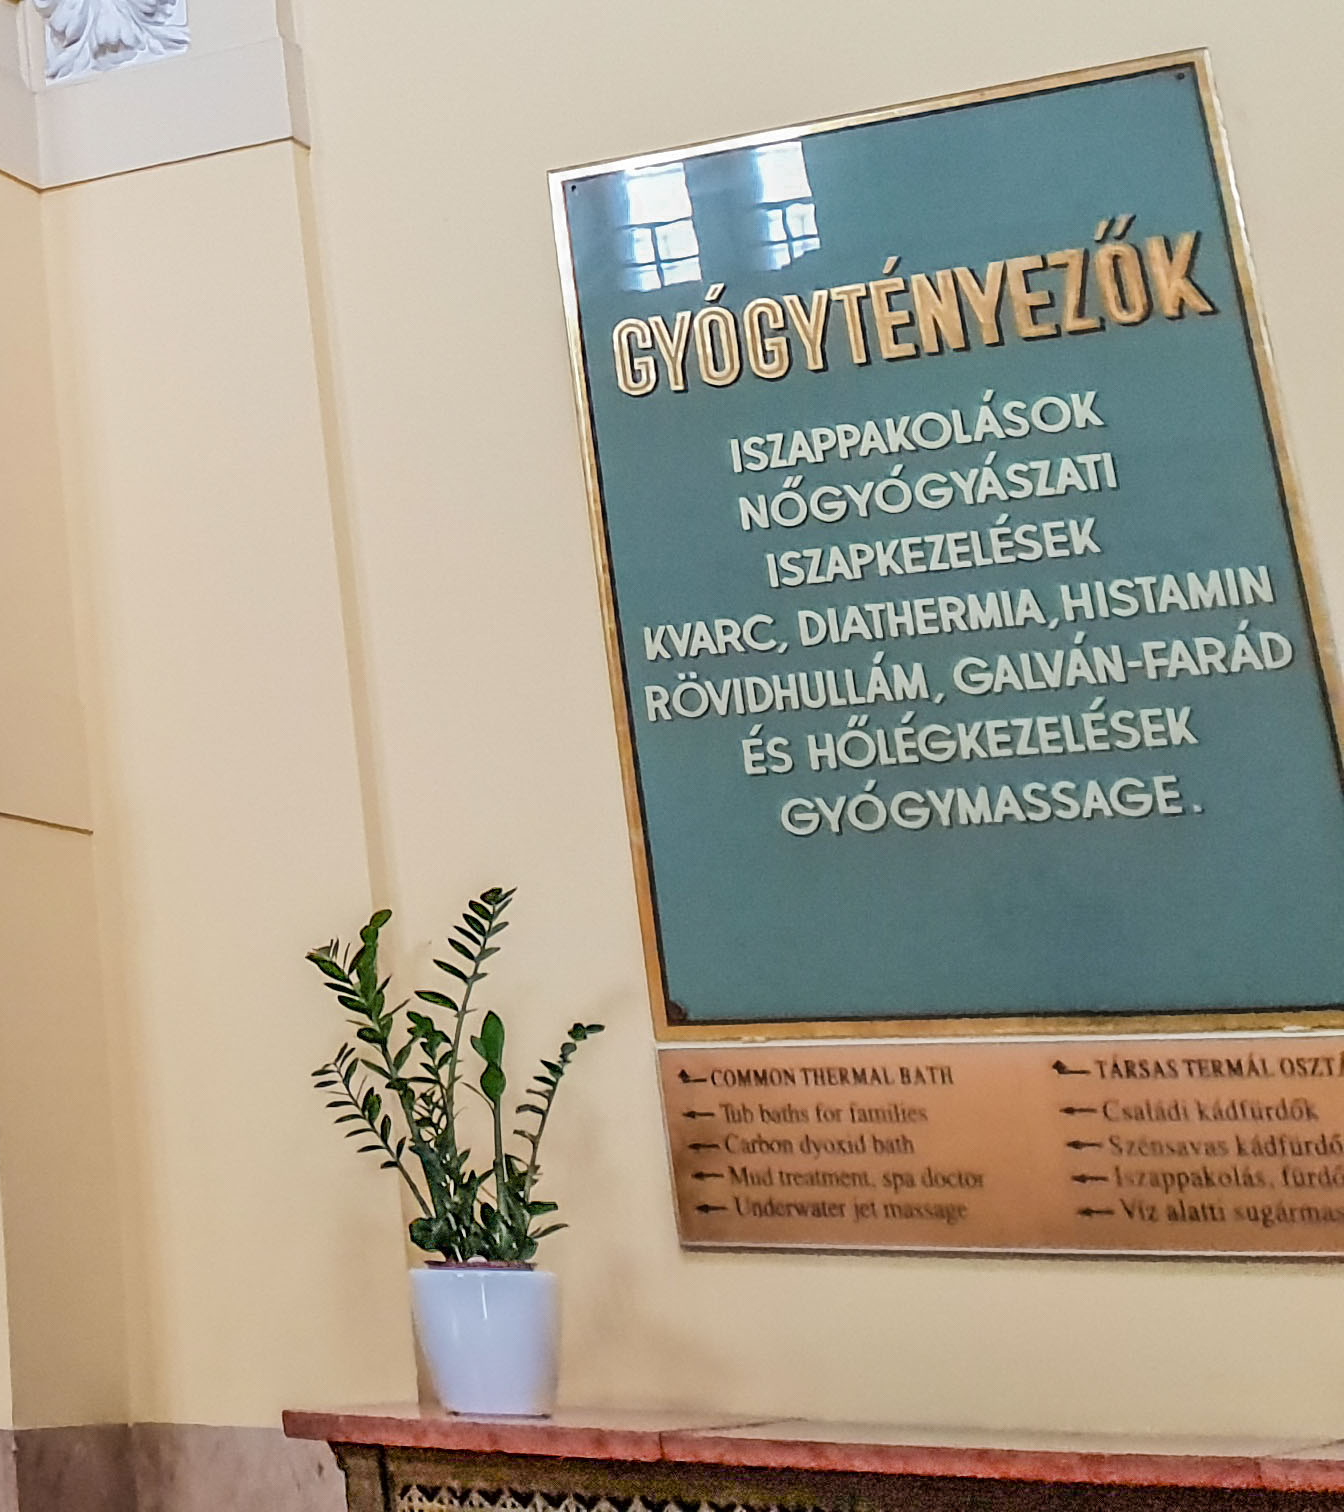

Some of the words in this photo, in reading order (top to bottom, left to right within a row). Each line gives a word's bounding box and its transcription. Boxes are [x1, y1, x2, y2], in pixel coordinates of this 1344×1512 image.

[612, 214, 1218, 396] GYÓGYTÉNYEZŐK
[730, 389, 1104, 473] ISZAPPAKOLÁSOK
[739, 451, 1118, 531] NŐGYÓGYÁSZATI
[766, 513, 1101, 588] ISZAPKEZELÉSEK
[643, 614, 788, 660] KVARC,
[798, 589, 1059, 646] DIATHERMIA,
[1060, 565, 1274, 621] HISTAMIN
[644, 651, 945, 721] RÖVIDHULLÁM,
[953, 619, 1293, 695] GALVÁN-FARÁD
[742, 724, 795, 775] ÉS
[807, 696, 1199, 770] HŐLÉGKEZELÉSEK
[711, 1067, 796, 1086] COMMON
[800, 1066, 896, 1086] THERMAL
[900, 1065, 954, 1085] BATH
[1095, 1055, 1178, 1079] TÁRSAS
[1182, 1052, 1275, 1078] TERMÁL
[719, 1102, 754, 1124] Tub
[760, 1102, 810, 1124] baths
[815, 1101, 844, 1123] for
[849, 1101, 928, 1124] families
[1102, 1098, 1188, 1122] Családi
[725, 1133, 793, 1155] Carbon
[799, 1134, 866, 1159] dyoxid
[873, 1134, 915, 1155] bath
[728, 1165, 772, 1188] Mud
[882, 1171, 917, 1194] spa
[921, 1166, 984, 1188] doctor
[733, 1195, 845, 1218] Underwater
[852, 1198, 877, 1223] jet
[883, 1200, 968, 1225] massage
